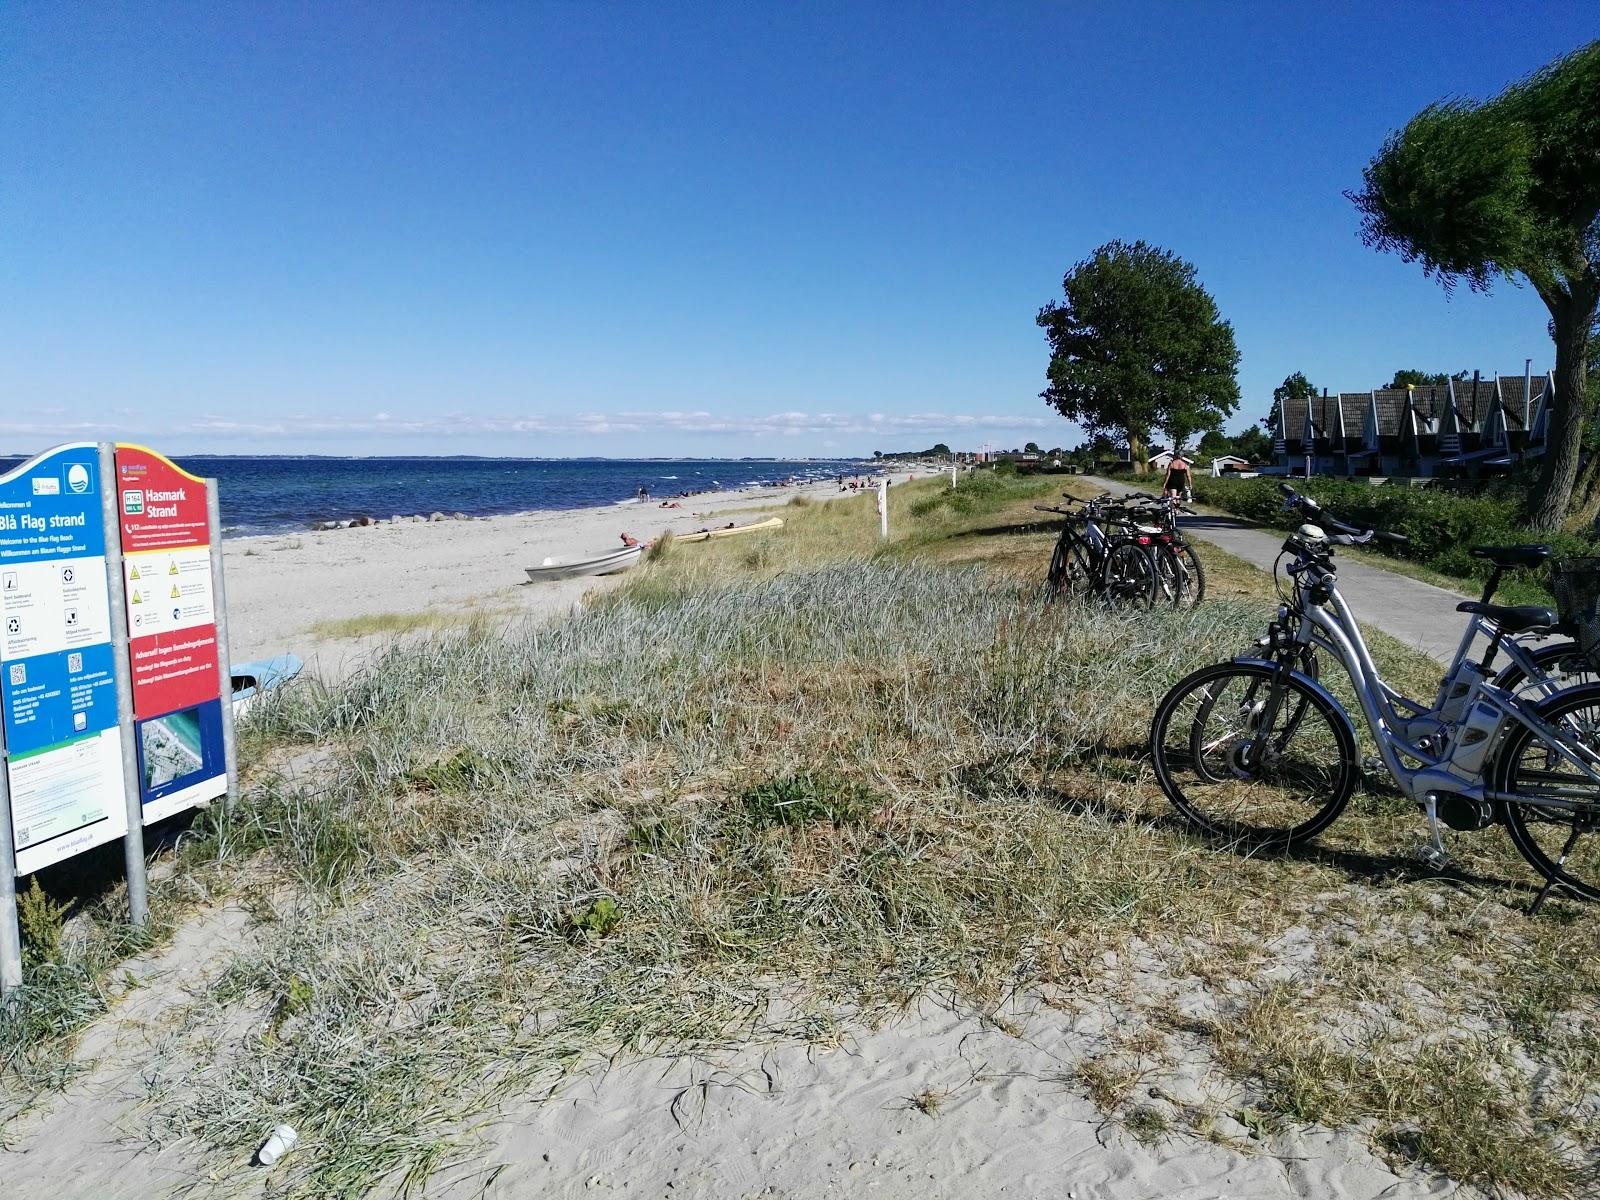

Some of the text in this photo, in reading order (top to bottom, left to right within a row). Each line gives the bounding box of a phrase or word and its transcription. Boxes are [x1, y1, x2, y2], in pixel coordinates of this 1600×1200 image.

[145, 488, 186, 502] Hasmark
[147, 504, 178, 518] Strand
[0, 511, 85, 532] Blå Flag strand
[49, 534, 60, 543] Flag
[60, 534, 74, 542] Beach
[0, 549, 31, 557] Willkommen
[72, 544, 87, 552] Strand
